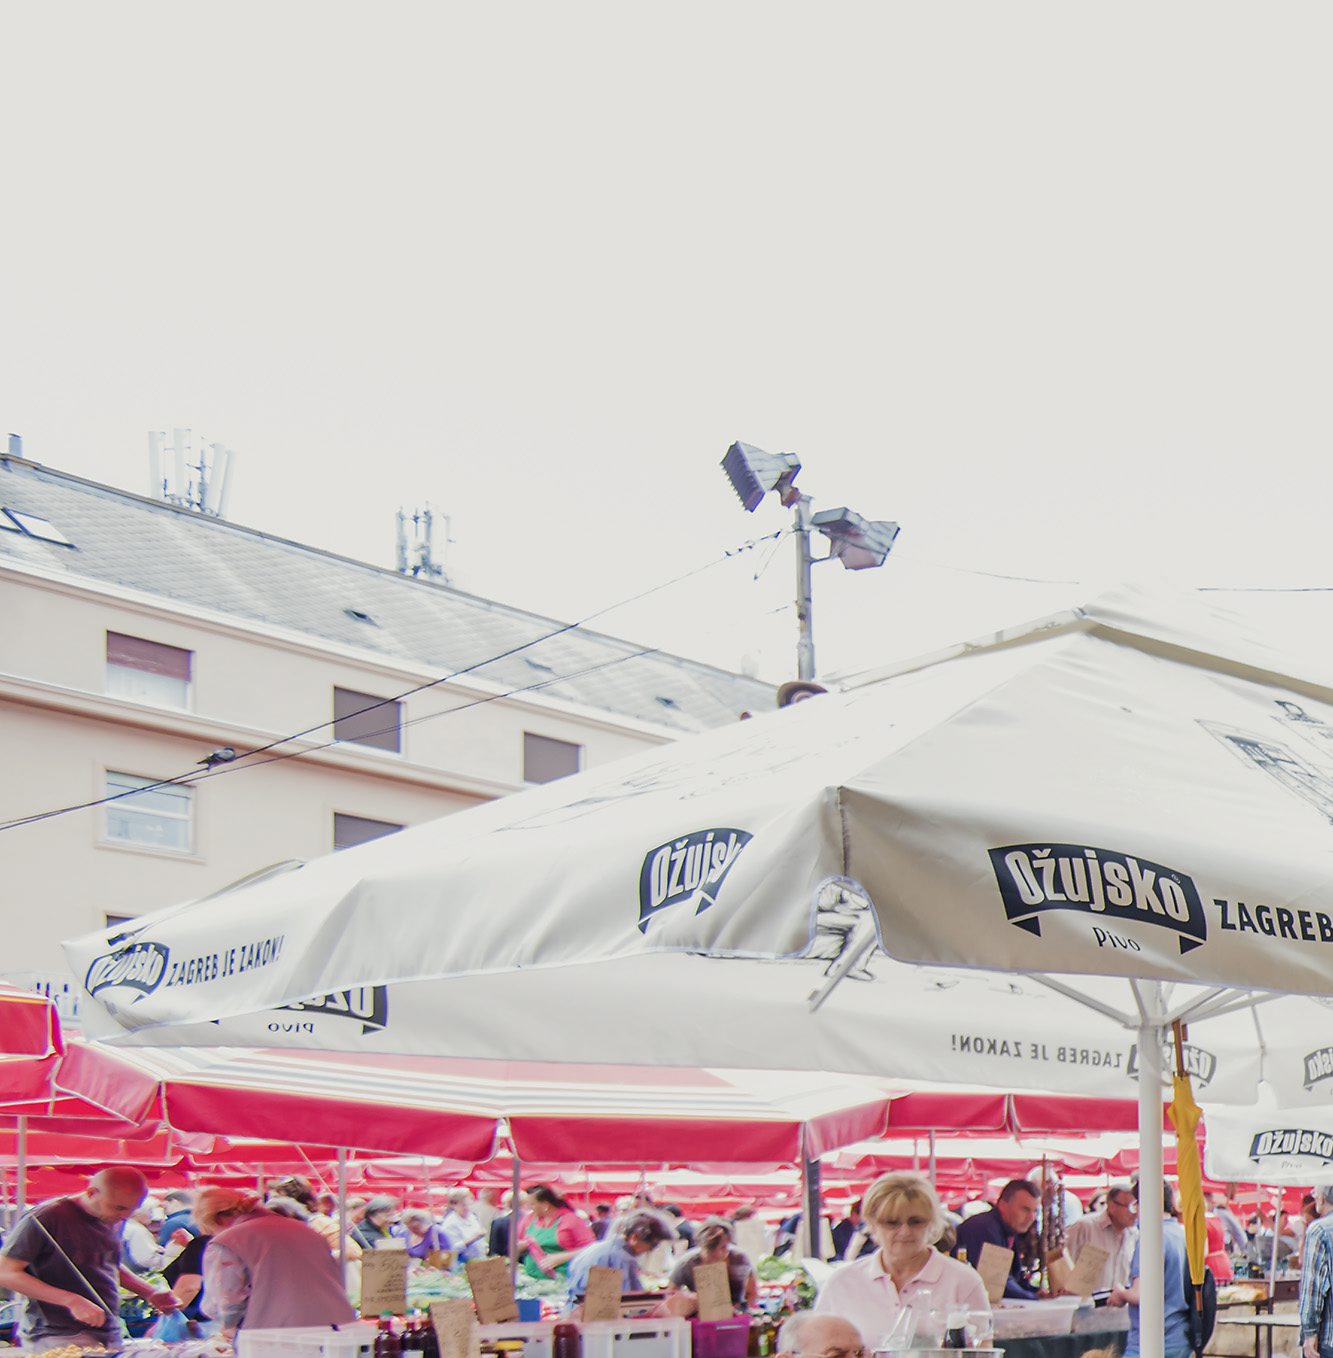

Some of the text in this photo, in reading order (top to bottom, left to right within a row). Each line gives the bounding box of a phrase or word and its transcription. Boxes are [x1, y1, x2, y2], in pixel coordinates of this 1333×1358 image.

[650, 832, 742, 907] Ožujsk
[1004, 848, 1190, 923] Ožujsko
[166, 954, 218, 987] ZAGREB
[222, 948, 235, 977] JE
[239, 935, 285, 973] ZAKON!
[1256, 1129, 1333, 1157] Ožujsko
